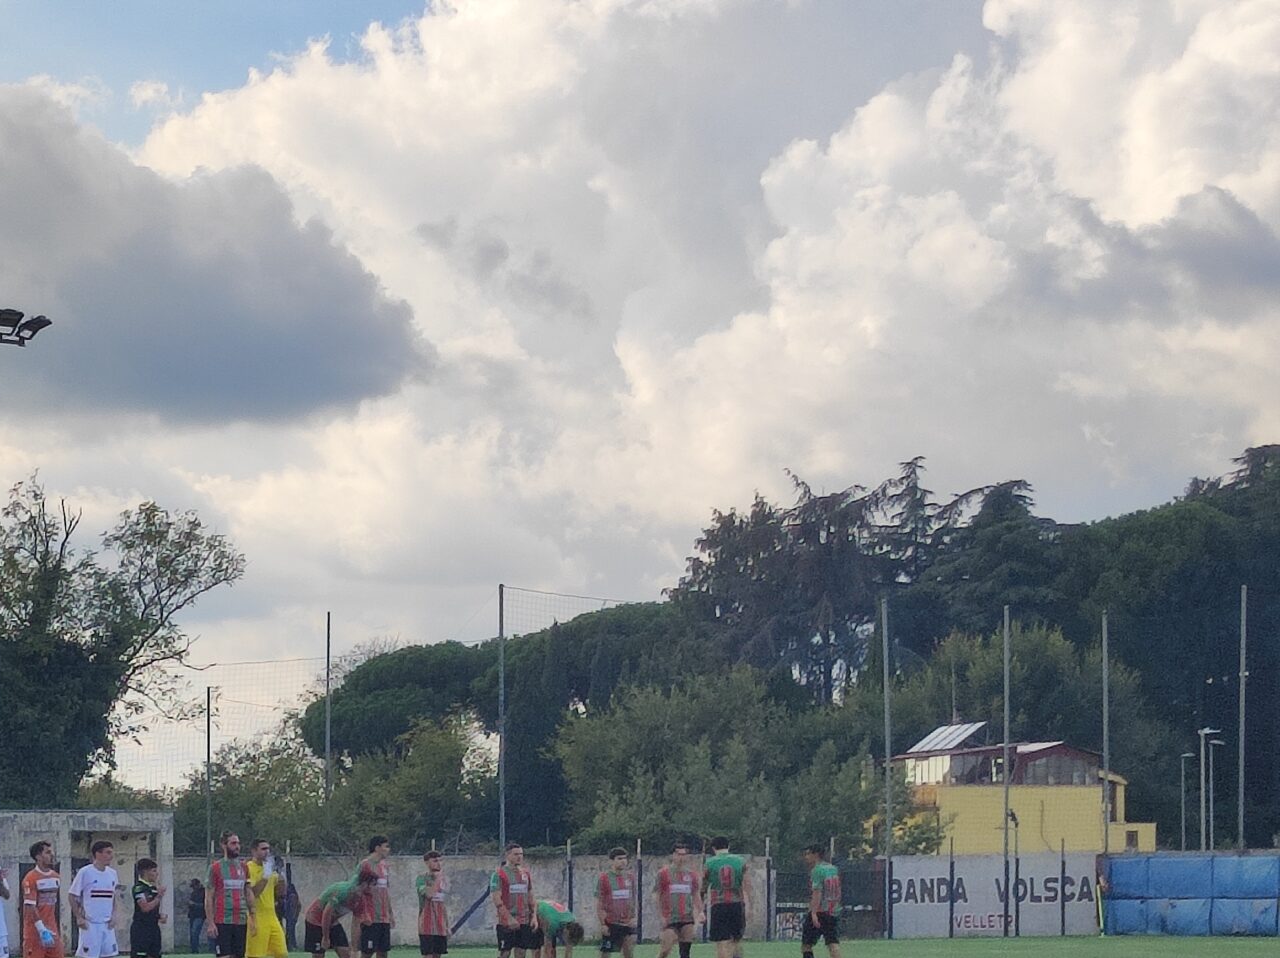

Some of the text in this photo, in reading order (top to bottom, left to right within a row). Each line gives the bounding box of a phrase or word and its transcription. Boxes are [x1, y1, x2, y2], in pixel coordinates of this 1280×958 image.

[889, 876, 1095, 904] BANDA VOLSCA
[954, 914, 1018, 929] VELLETR
